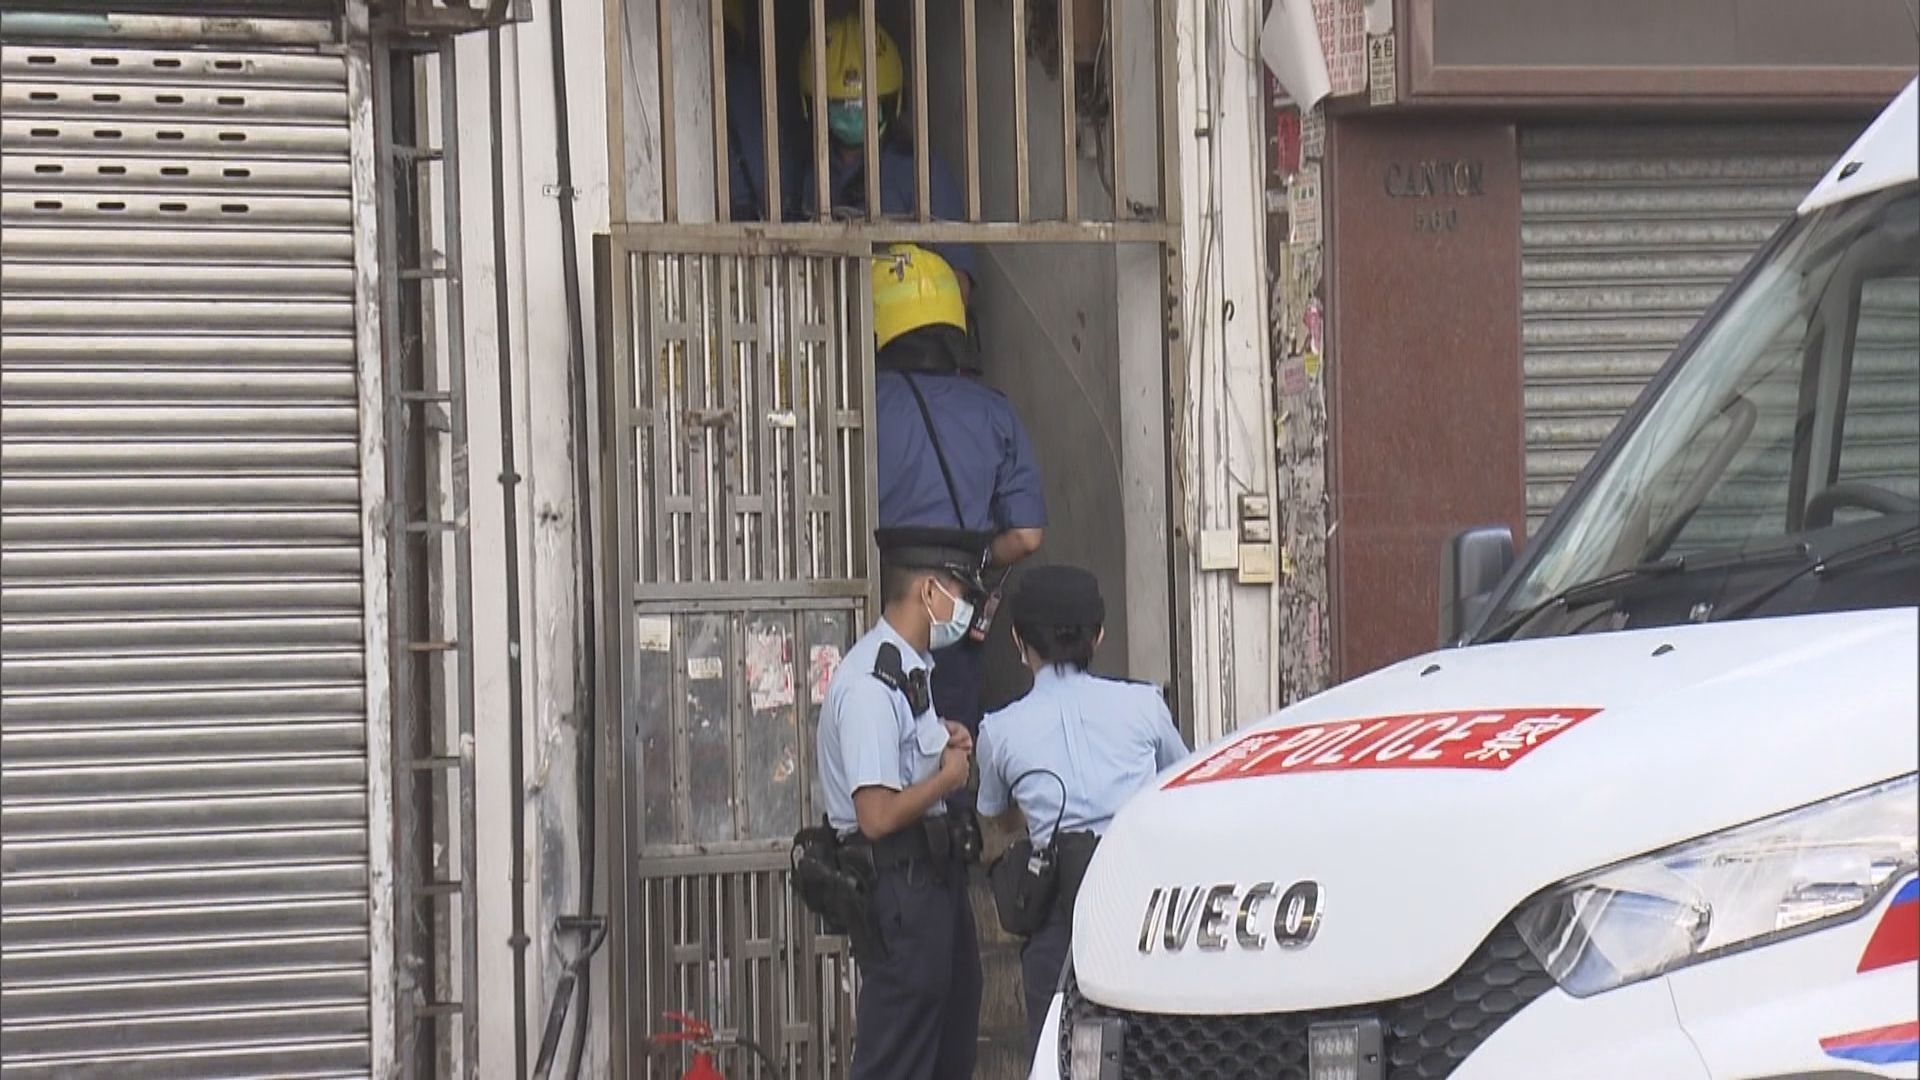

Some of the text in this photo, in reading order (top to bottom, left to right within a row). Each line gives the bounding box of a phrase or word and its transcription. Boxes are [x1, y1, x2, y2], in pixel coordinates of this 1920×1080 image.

[1383, 159, 1485, 197] CANTON
[1239, 713, 1506, 771] POLICE
[1463, 713, 1575, 761] 察
[1136, 878, 1327, 955] IVECO
